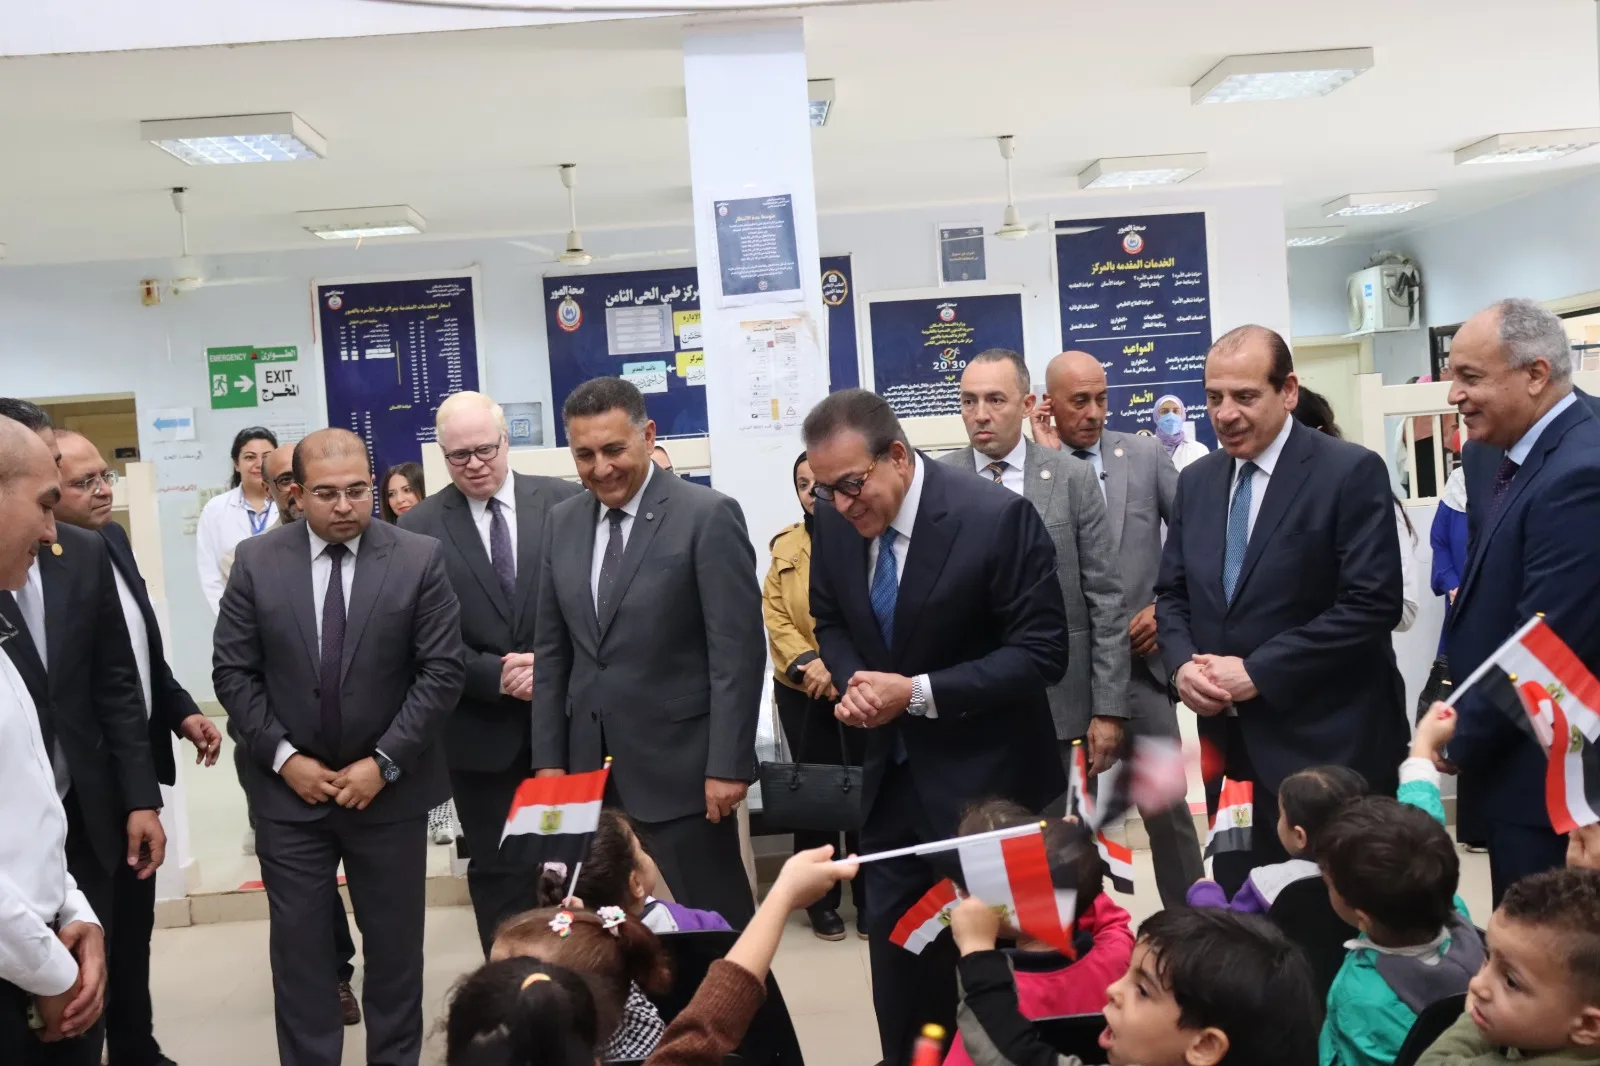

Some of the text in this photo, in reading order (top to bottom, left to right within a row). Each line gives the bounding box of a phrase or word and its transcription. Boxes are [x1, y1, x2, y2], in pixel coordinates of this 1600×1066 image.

[1091, 257, 1174, 275] الخدمات المقدمه بالمركز
[550, 285, 585, 300] صحة العبور
[606, 288, 632, 306] الثامن
[660, 286, 680, 304] طبي
[1123, 342, 1154, 356] المواعيد
[210, 353, 246, 362] EMERGENCY
[266, 370, 292, 384] EXIT
[262, 384, 299, 402] المخرج
[1128, 390, 1154, 406] الأسعار
